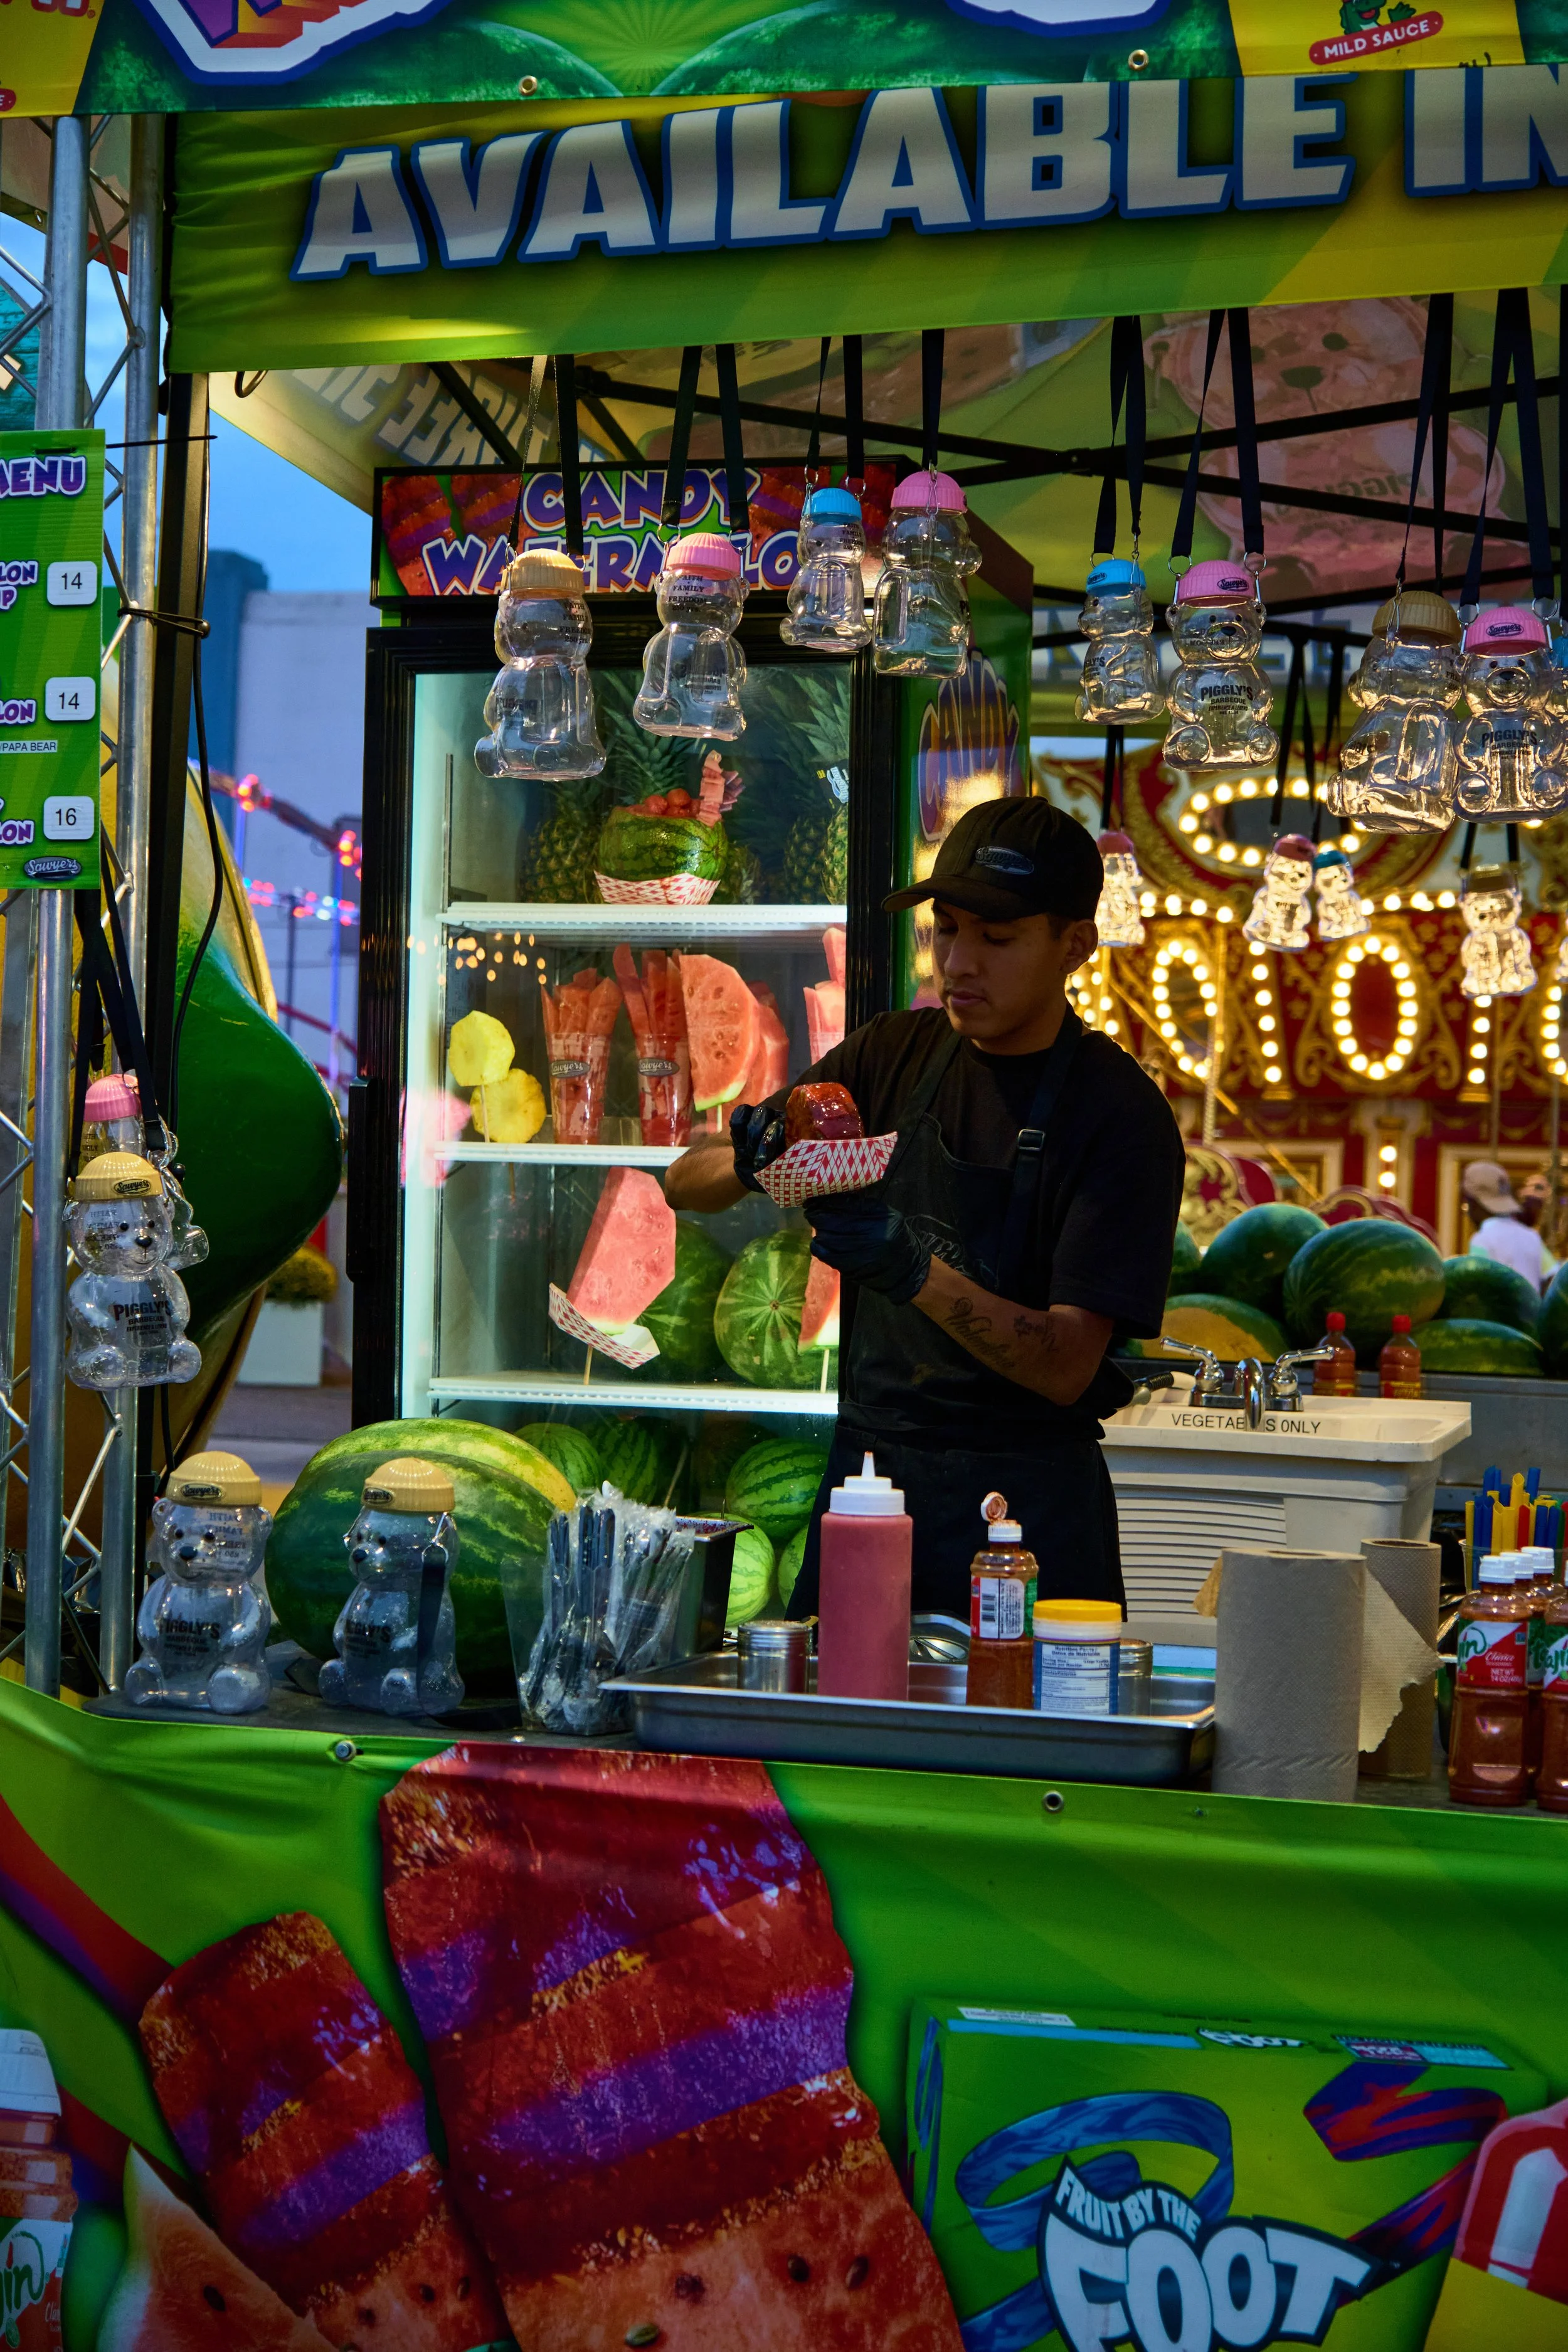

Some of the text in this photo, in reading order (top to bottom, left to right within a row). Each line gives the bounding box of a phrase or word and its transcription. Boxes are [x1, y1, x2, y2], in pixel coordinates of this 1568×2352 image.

[1323, 19, 1430, 58] MILD SAUCE
[290, 73, 1357, 282] AVAILABLE
[0, 456, 87, 497] ENU
[522, 469, 761, 531] CANDY
[61, 572, 83, 590] 14
[668, 596, 707, 604] FREEDOM
[1488, 623, 1522, 636] Sawyers
[58, 692, 80, 710] 14
[1201, 684, 1254, 702] PIGGLY'S
[1210, 697, 1247, 705] BARBEQUE
[30, 741, 57, 751] BEAR
[1481, 729, 1538, 748] PIGGLY'S
[55, 807, 77, 826] 16
[27, 858, 78, 875] Sawyers
[639, 1060, 672, 1073] Sawyers
[116, 1179, 150, 1192] Sawyers
[114, 1300, 173, 1322] PIGGLY'S
[129, 1316, 165, 1325] BARBEQUE
[1171, 1413, 1321, 1434] VEGETABS ONLY
[1054, 2164, 1202, 2245] FRUIT BY THE
[1045, 2212, 1374, 2352] FOOT
